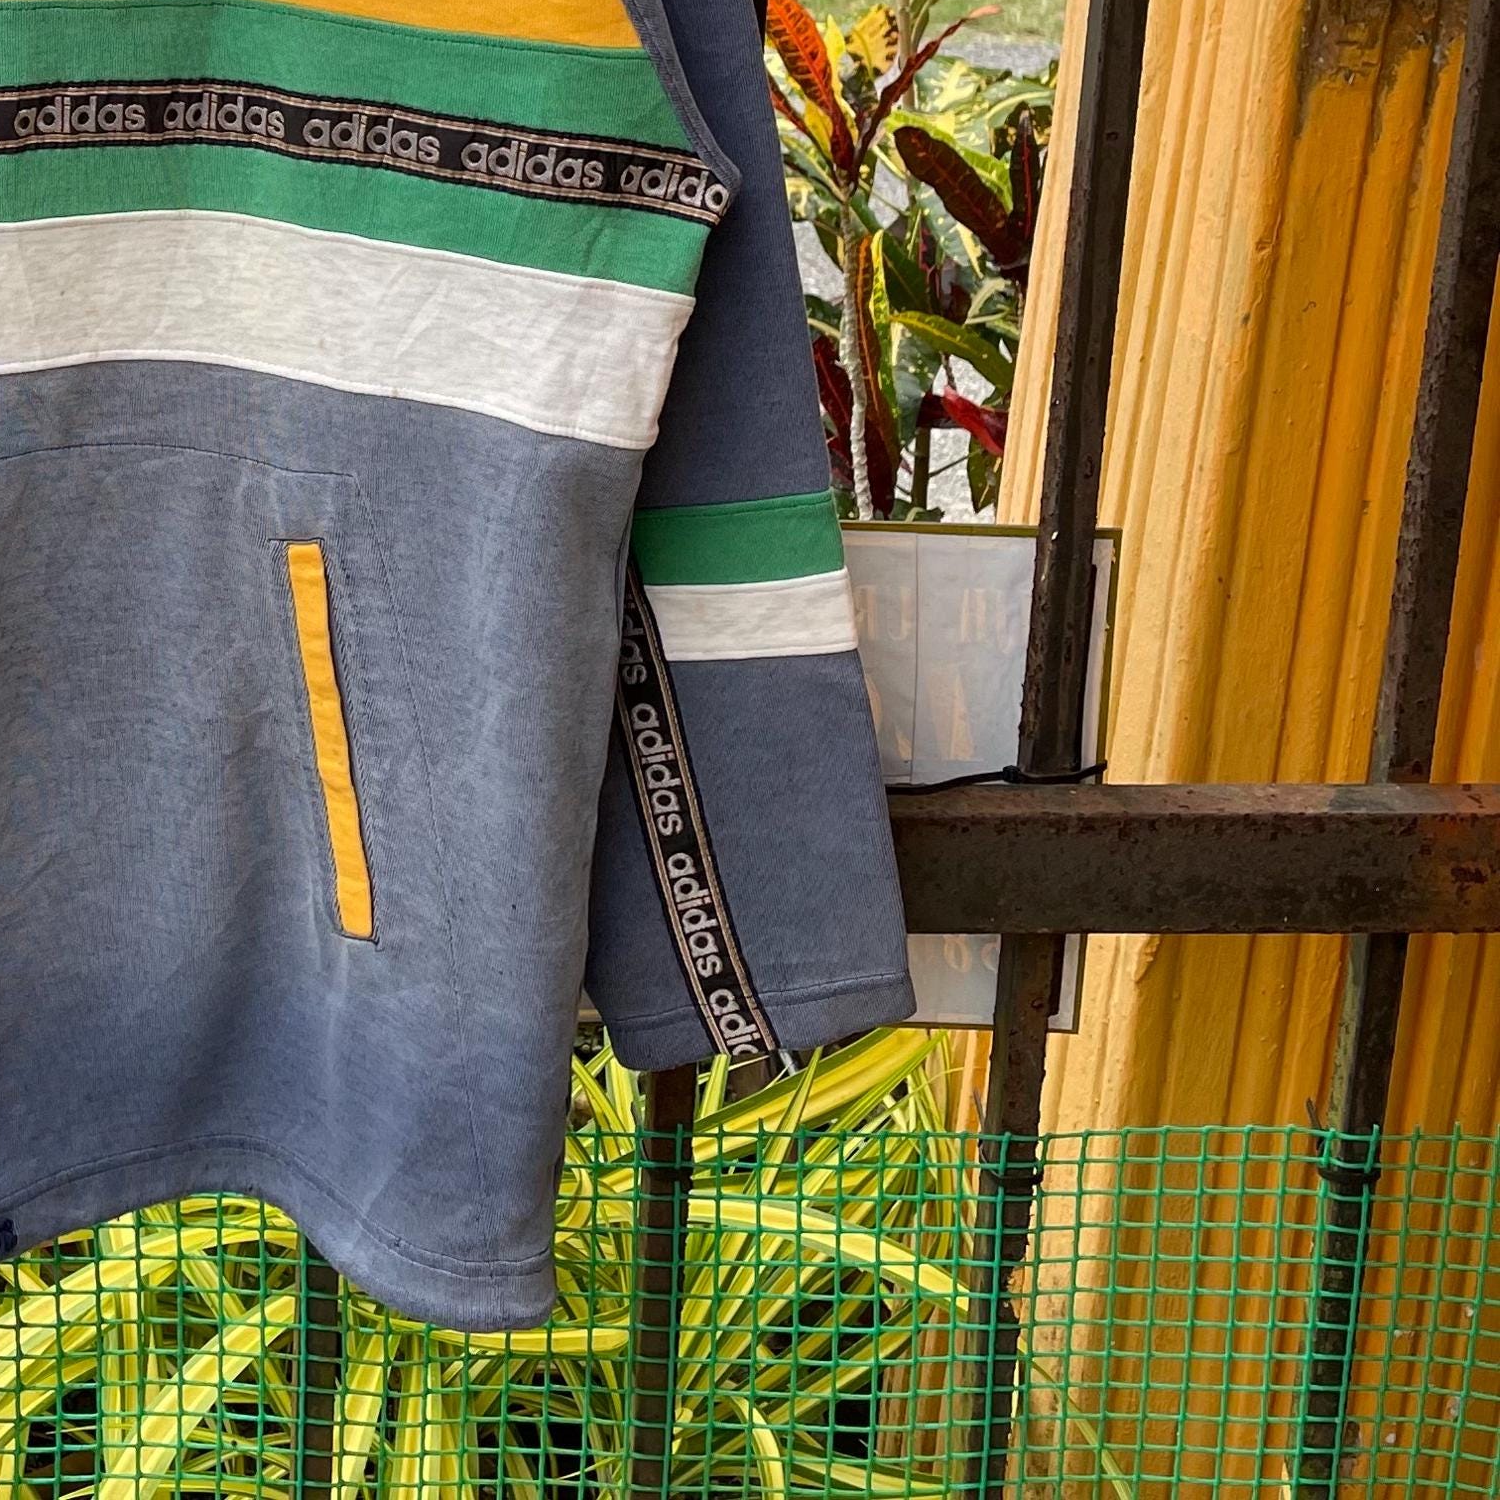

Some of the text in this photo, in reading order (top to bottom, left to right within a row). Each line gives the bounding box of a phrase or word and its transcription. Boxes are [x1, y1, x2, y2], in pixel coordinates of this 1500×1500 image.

[14, 96, 146, 136] adidas
[163, 92, 285, 140] adidas
[302, 113, 440, 165] adidas
[461, 138, 604, 190] adidas
[631, 702, 685, 837] adidas
[666, 852, 724, 978] adidas
